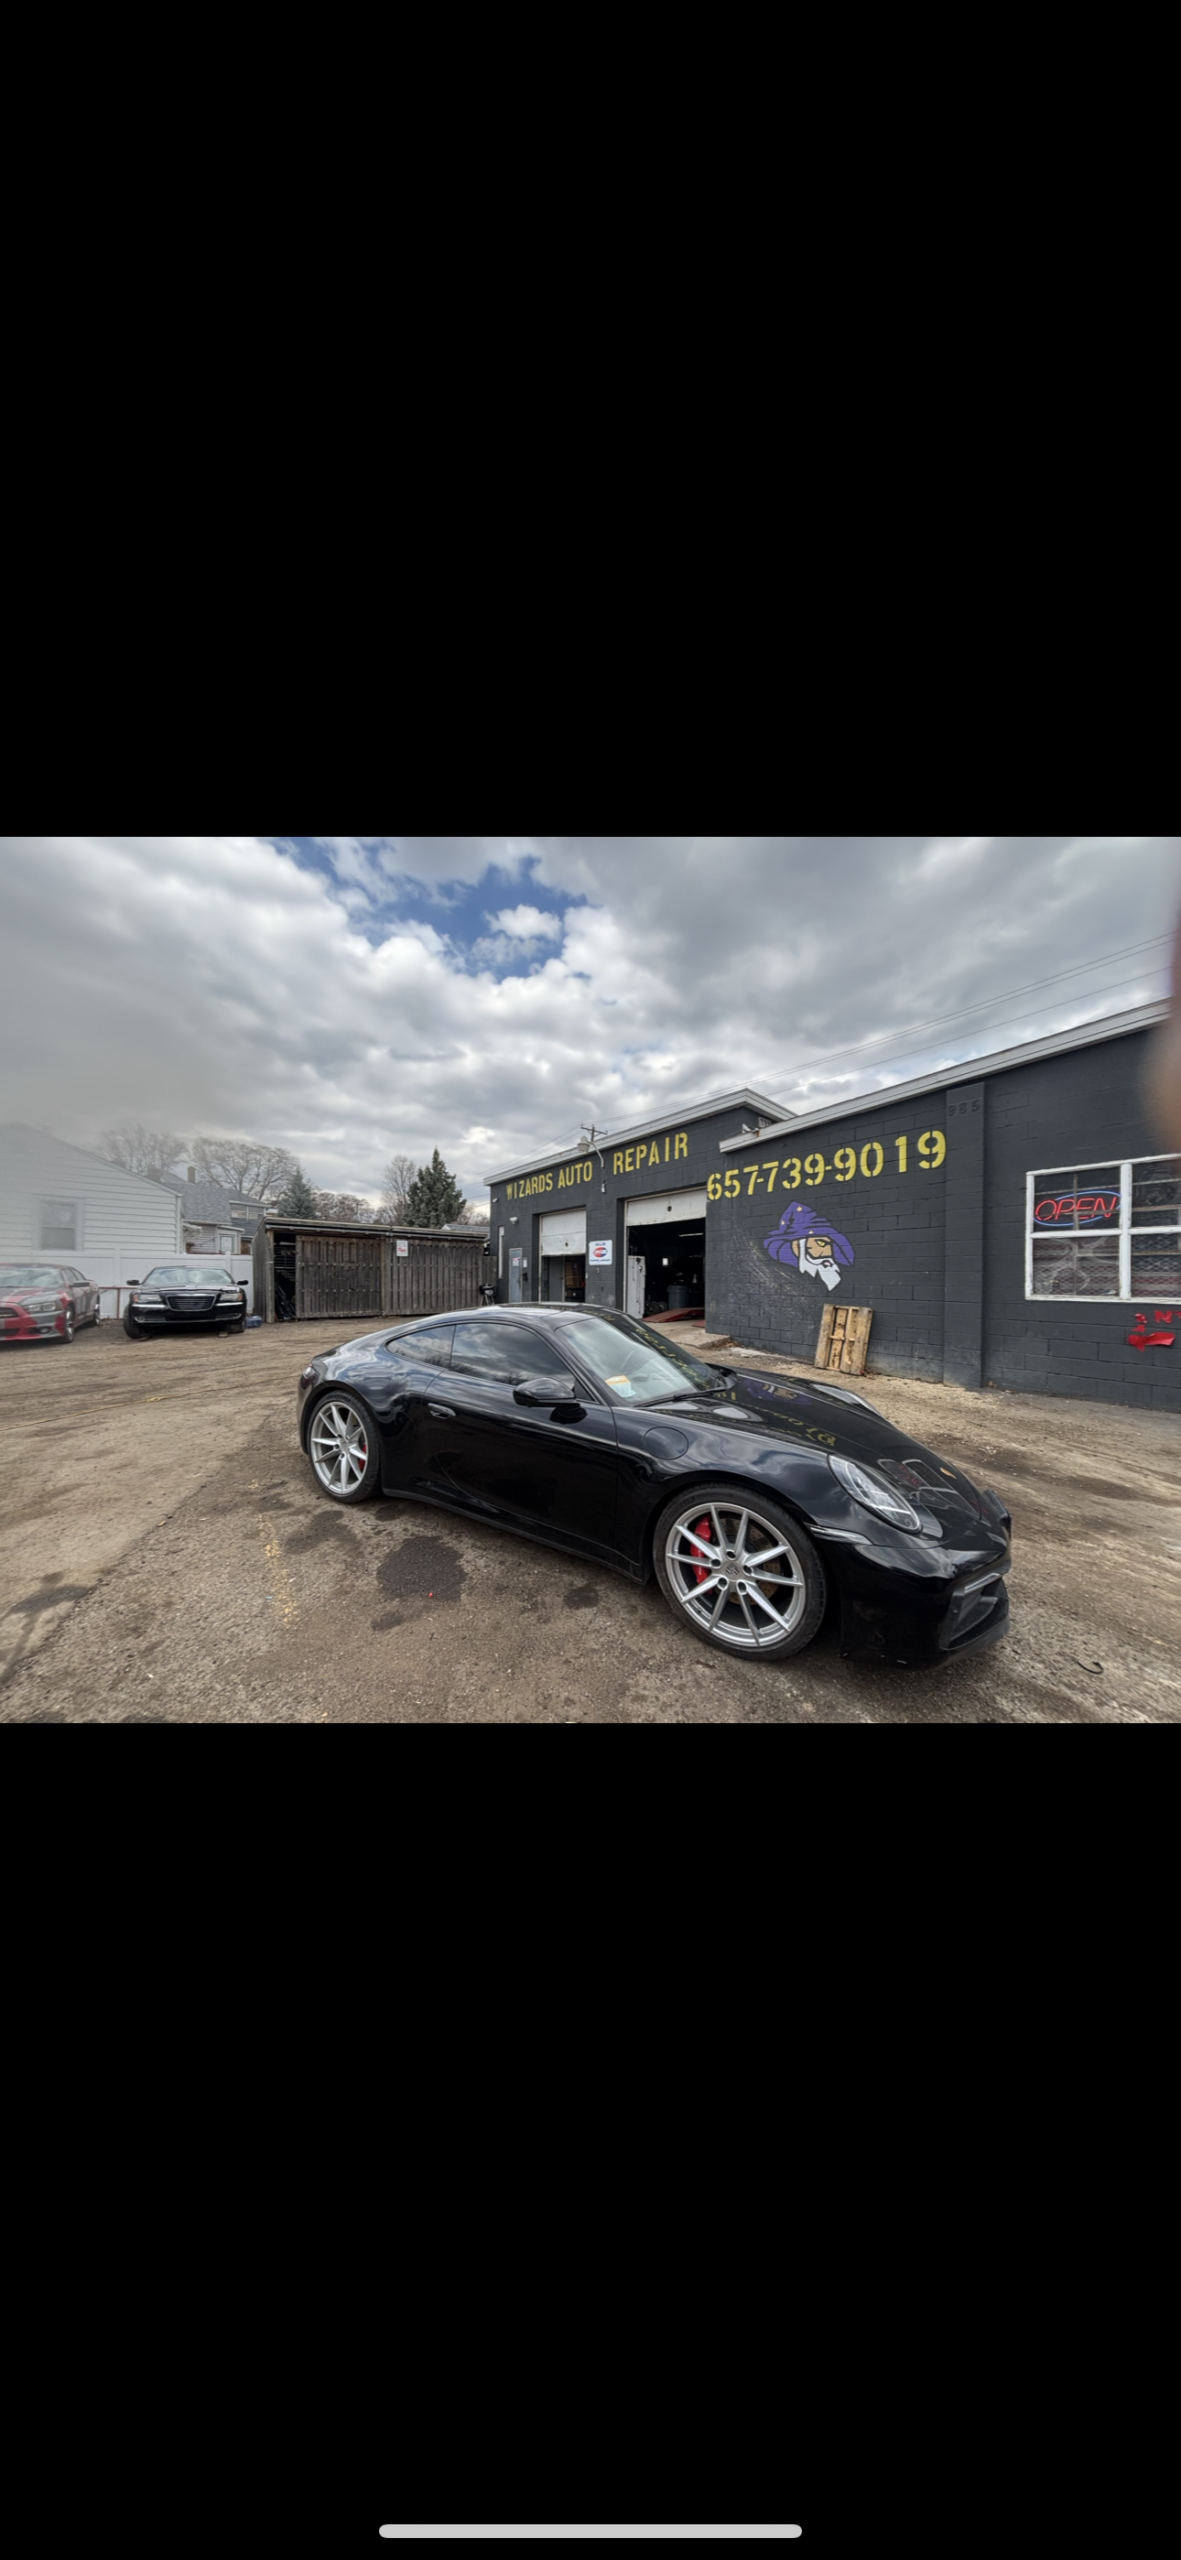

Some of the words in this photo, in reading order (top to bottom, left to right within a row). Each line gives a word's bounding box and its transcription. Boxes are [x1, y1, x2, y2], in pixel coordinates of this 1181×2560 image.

[506, 1173, 553, 1200] WIZARDS
[558, 1161, 593, 1189] AUTO
[613, 1132, 688, 1175] REPAIR
[707, 1130, 946, 1200] 657-739-9019
[1035, 1196, 1117, 1221] OPEN
